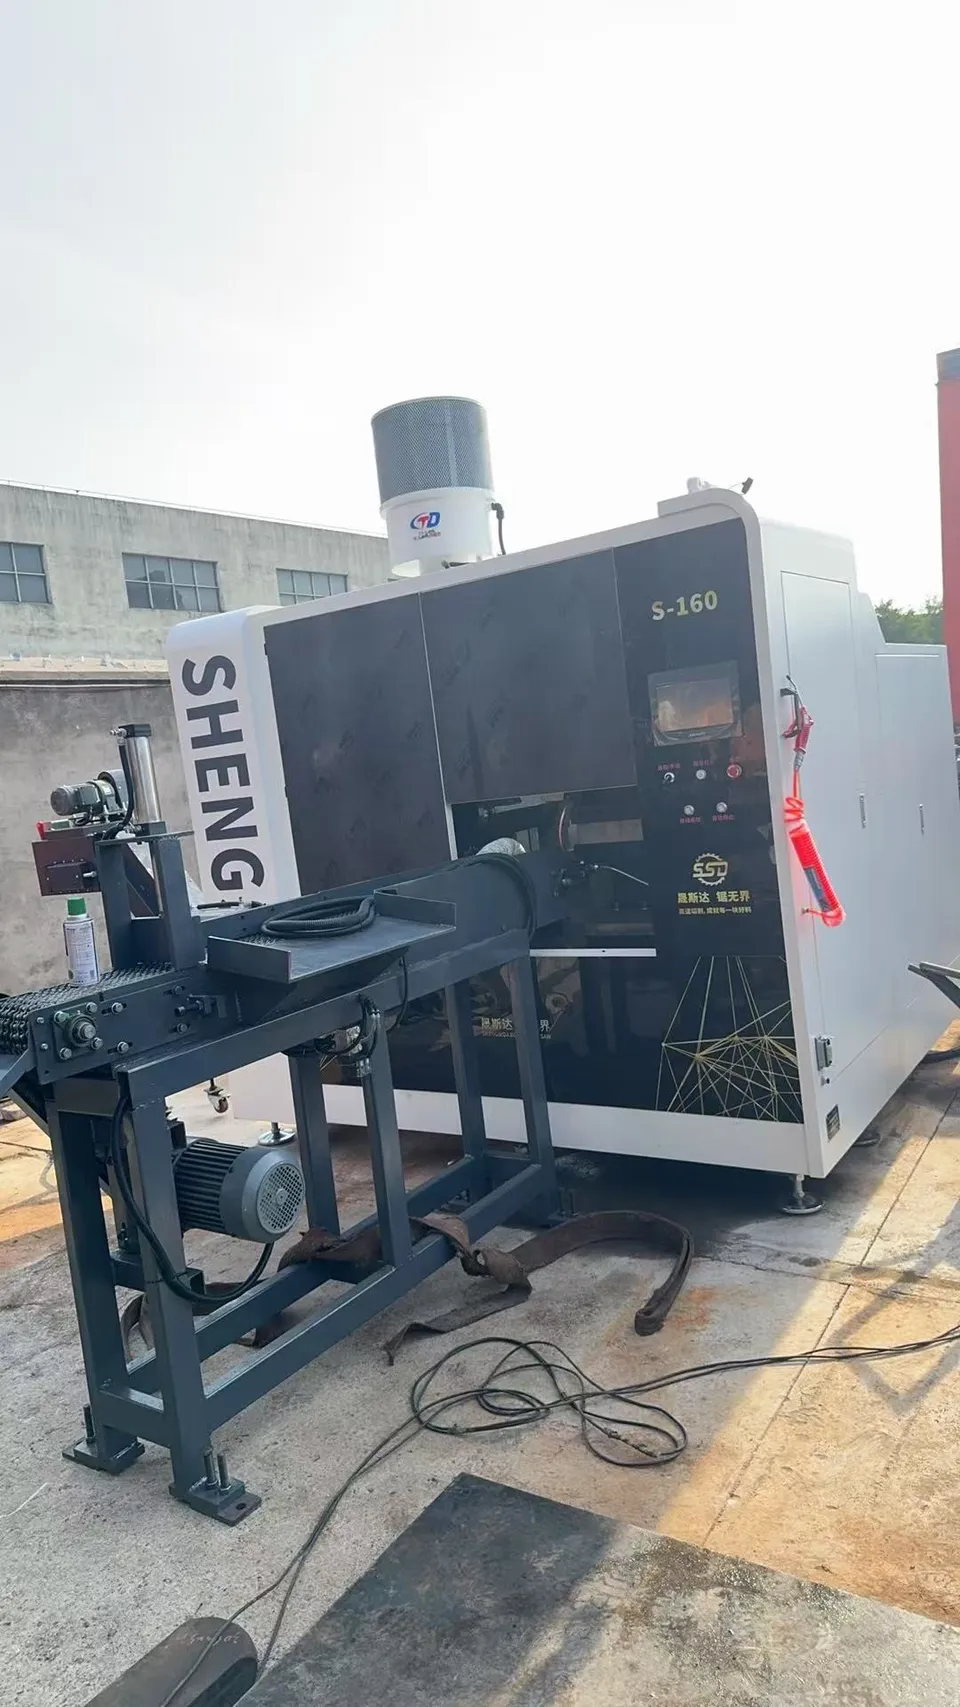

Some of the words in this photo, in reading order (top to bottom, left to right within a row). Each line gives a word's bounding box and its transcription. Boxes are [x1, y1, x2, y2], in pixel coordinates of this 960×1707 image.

[651, 590, 718, 620] S-160
[181, 655, 265, 891] SHENG
[692, 861, 728, 878] SSD
[716, 890, 750, 903] 锯无界
